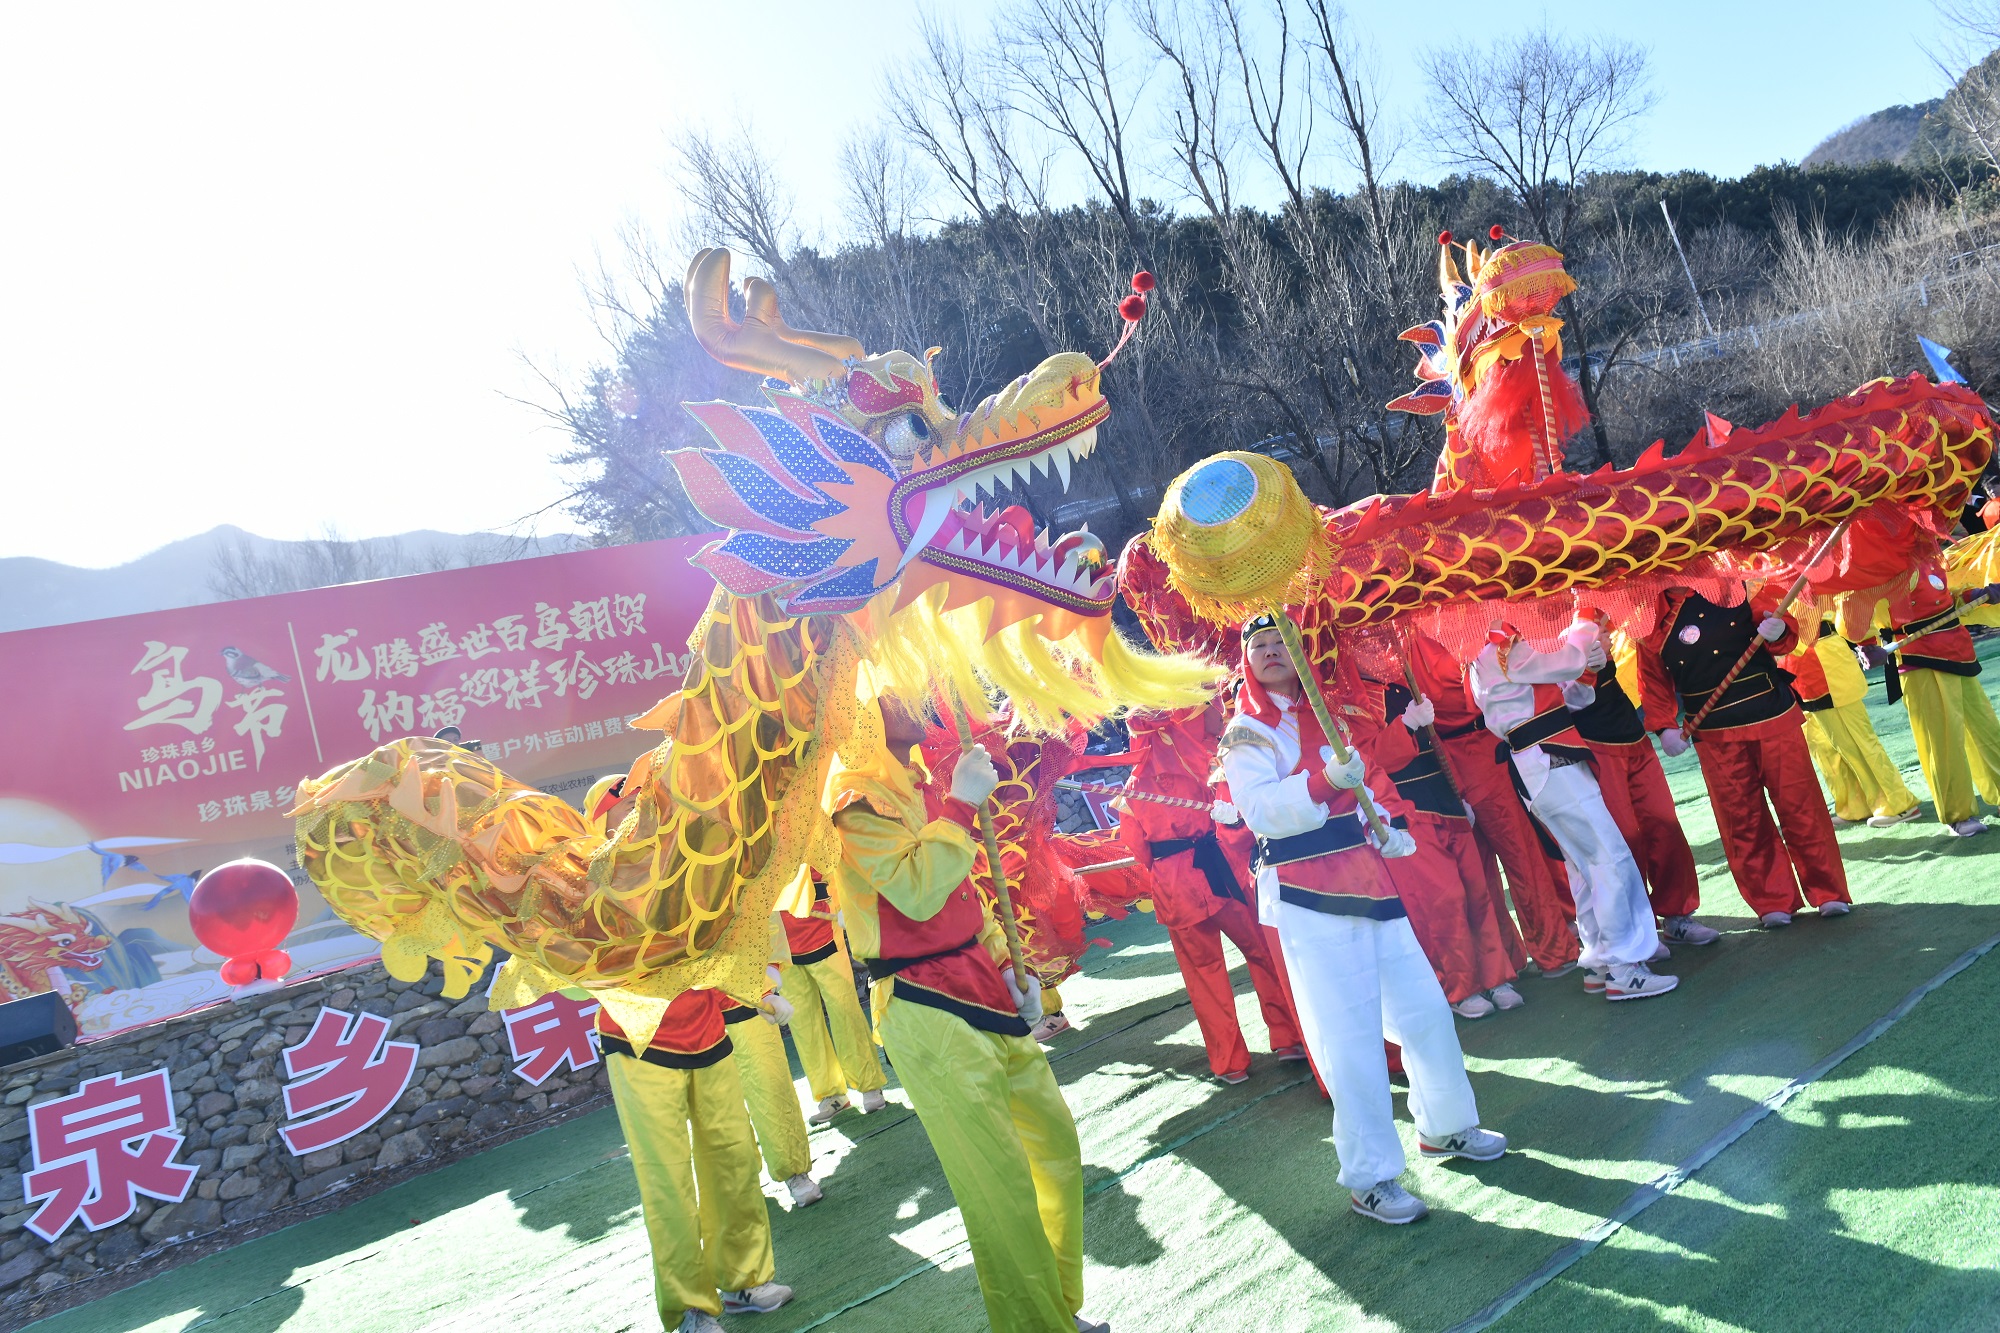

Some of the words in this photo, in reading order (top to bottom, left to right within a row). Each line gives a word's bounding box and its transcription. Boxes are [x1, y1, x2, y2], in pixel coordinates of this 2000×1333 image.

[314, 593, 647, 684] 龙腾盛世百鸟朝贺
[141, 736, 215, 763] 珍珠泉乡
[118, 749, 247, 793] NIAOJIE
[197, 785, 296, 823] 珍珠泉乡
[1629, 977, 1646, 989] N
[1445, 1138, 1467, 1151] N
[1364, 1193, 1382, 1211] N
